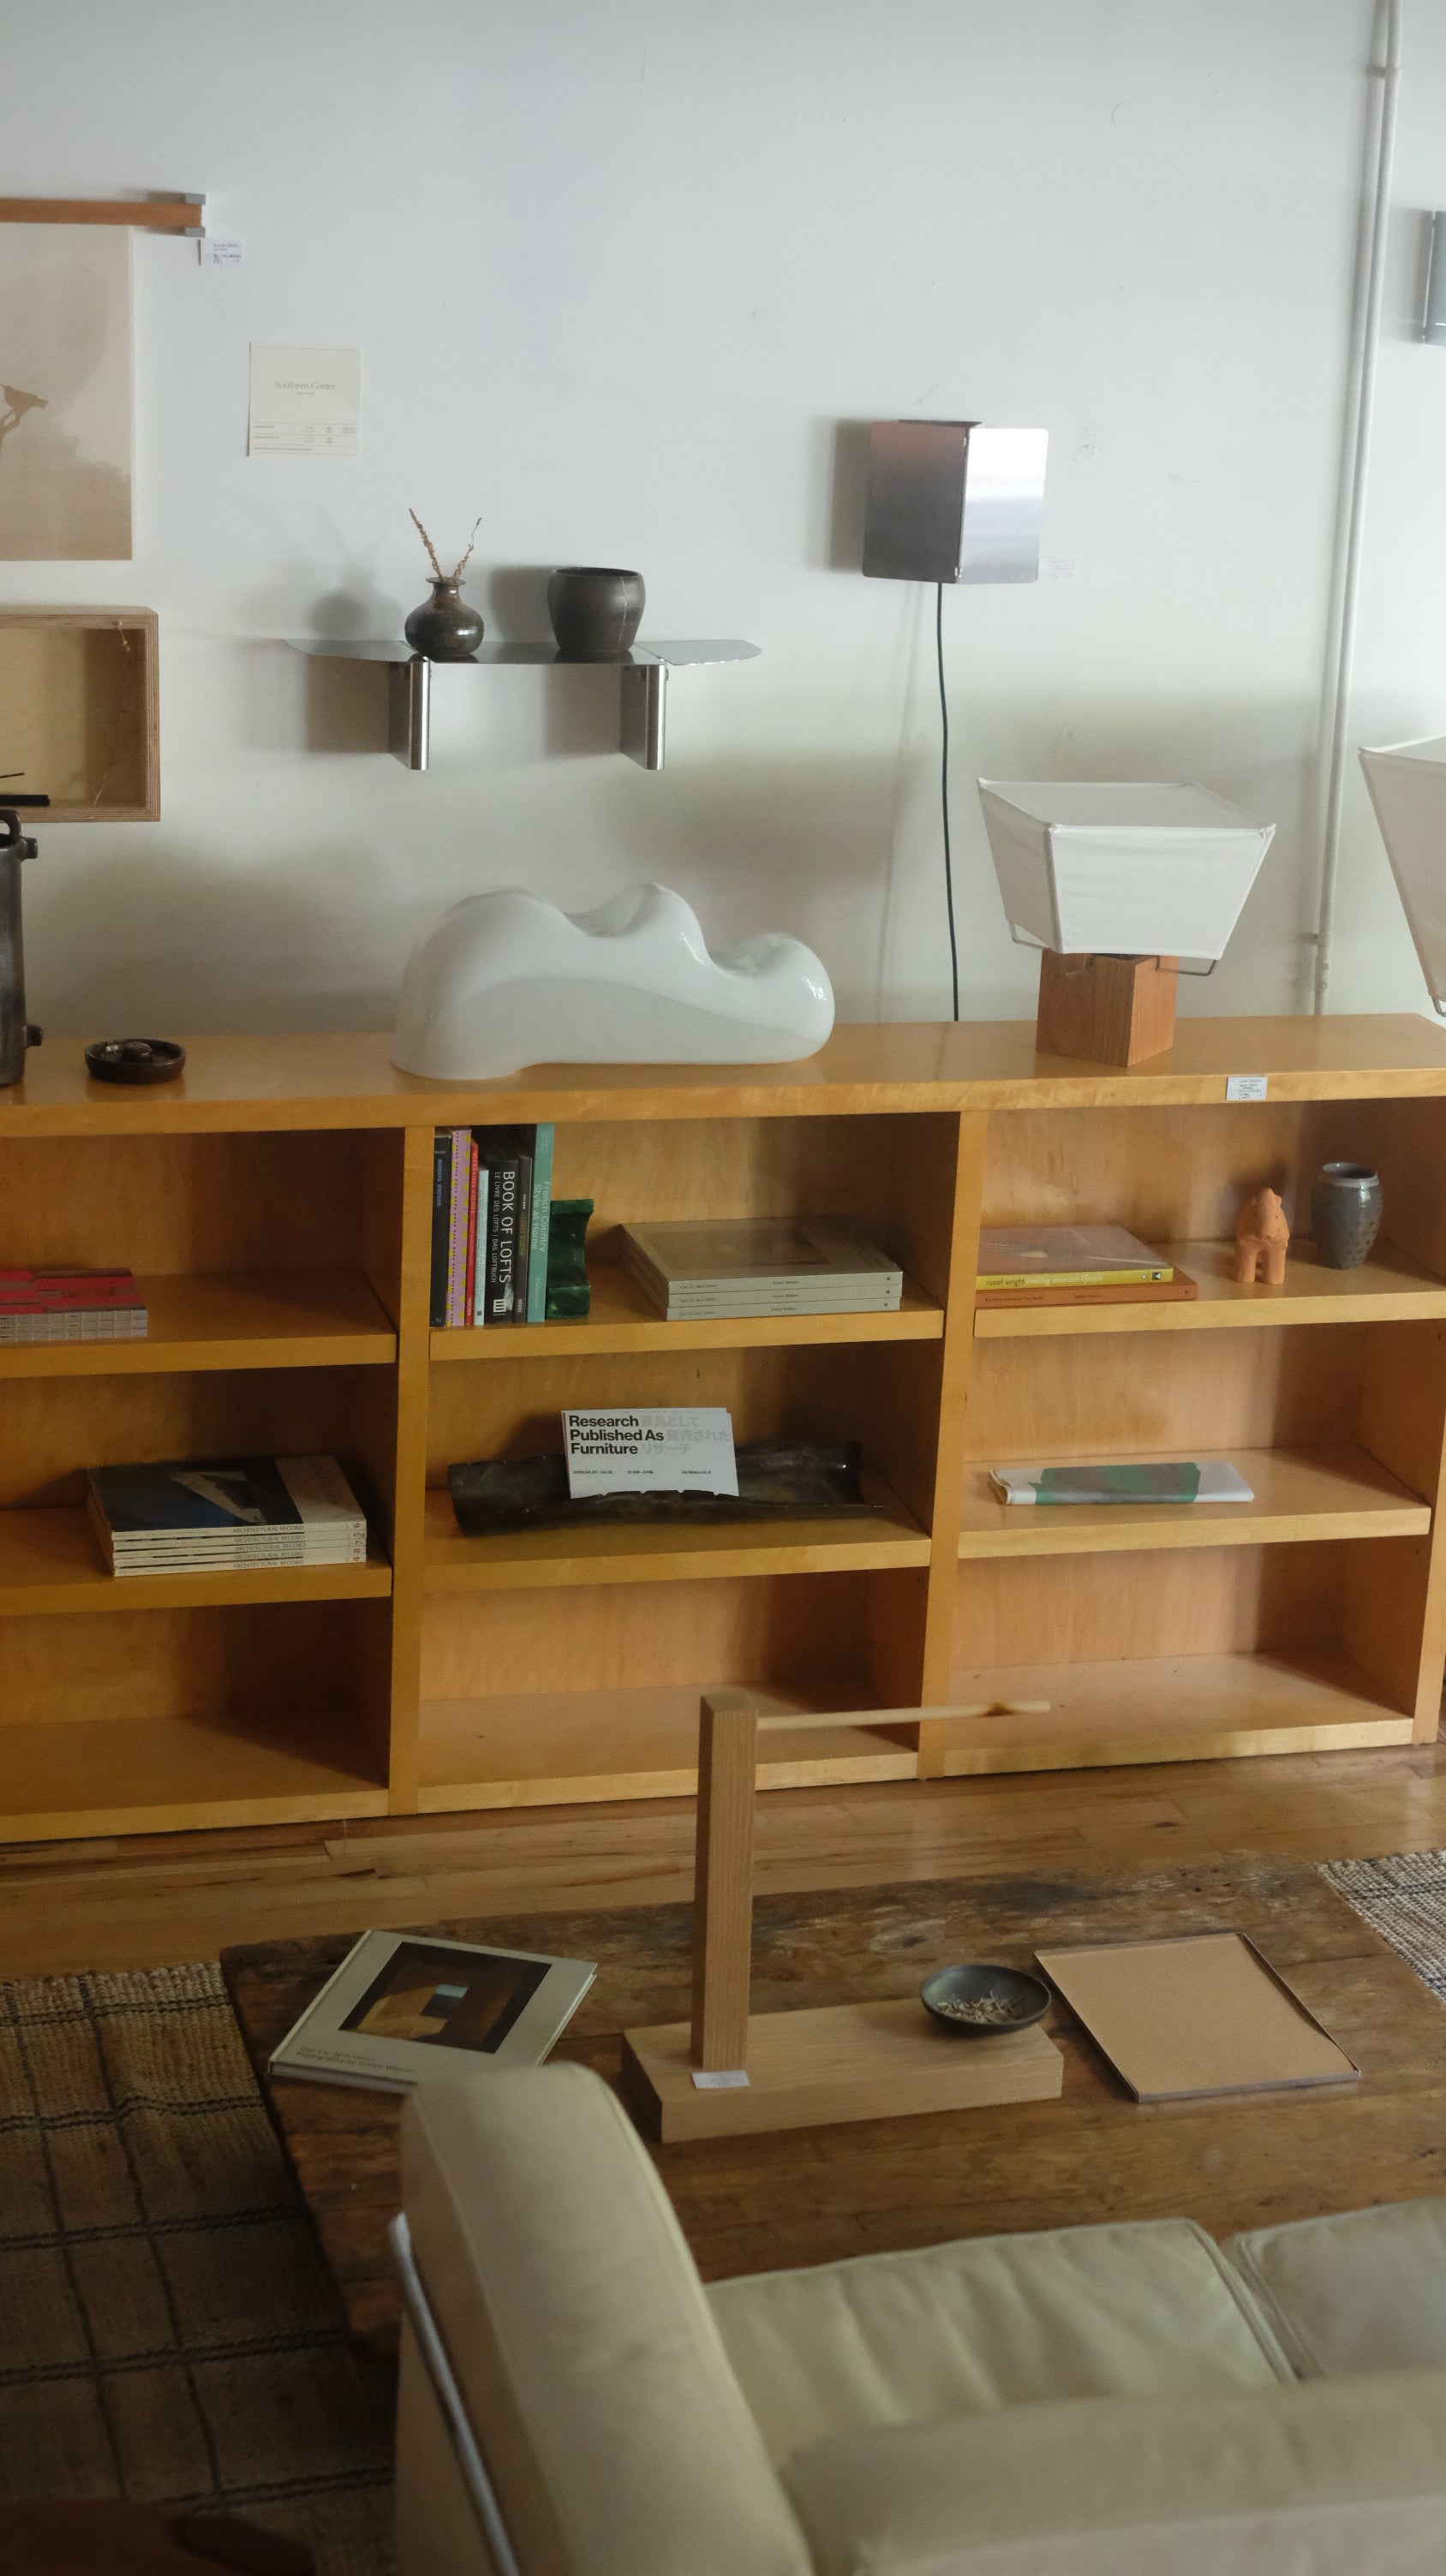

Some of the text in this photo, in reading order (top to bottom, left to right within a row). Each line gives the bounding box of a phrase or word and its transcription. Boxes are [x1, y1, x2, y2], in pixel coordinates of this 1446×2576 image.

[533, 1184, 541, 1207] Style
[533, 1211, 539, 1220] at
[499, 1172, 516, 1284] BOOK OF LOFTS
[539, 1218, 549, 1253] Country
[569, 1415, 638, 1428] Research
[570, 1428, 664, 1441] Published As
[571, 1442, 638, 1455] Furniture
[233, 1552, 280, 1560] ARCHITECTURAL
[233, 1560, 278, 1569] ARCHITECTURAL
